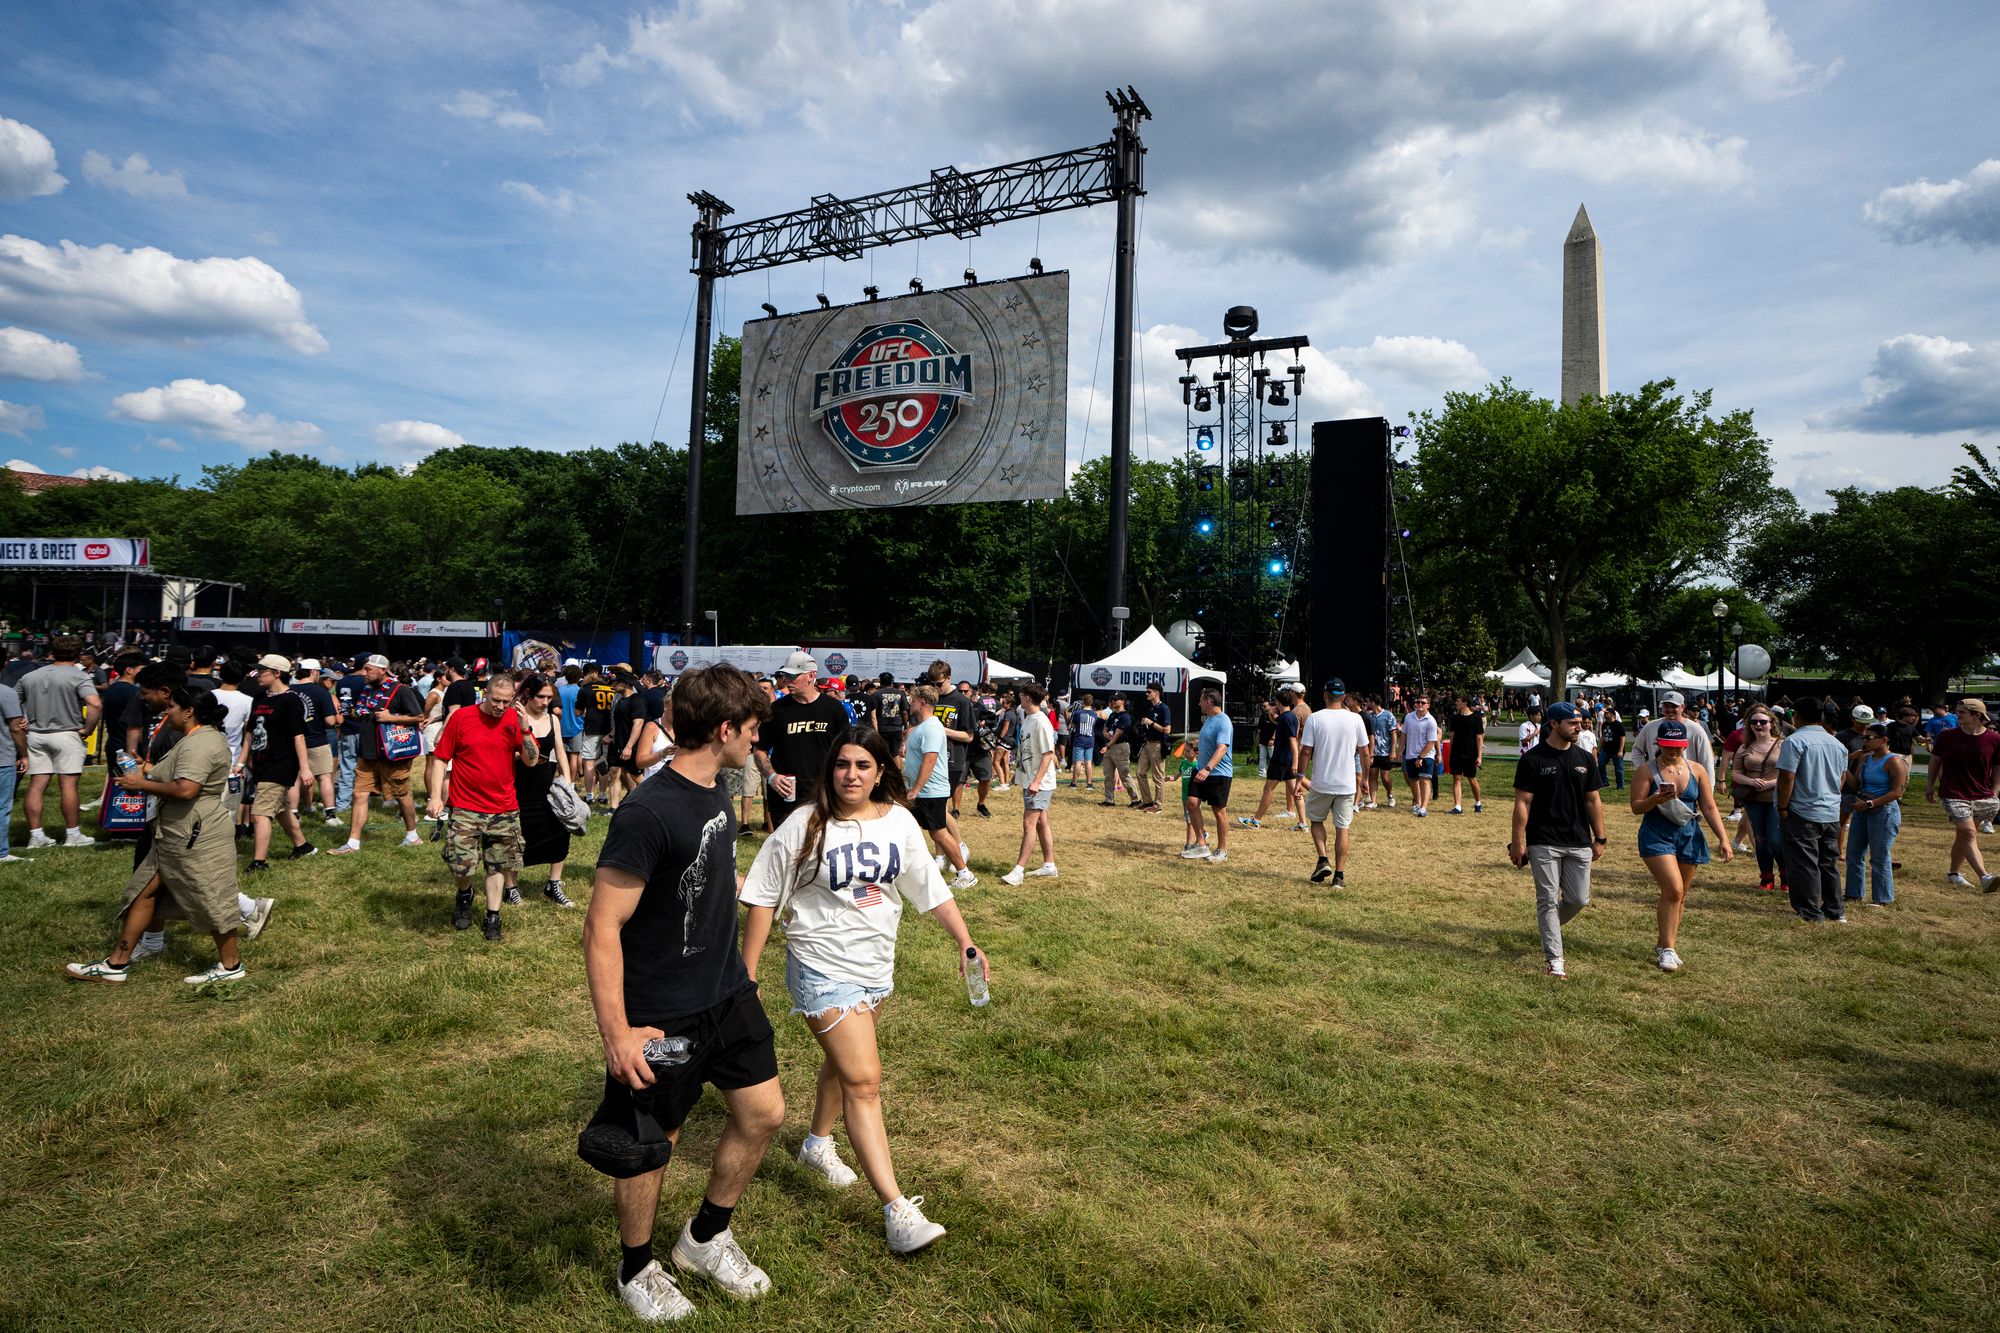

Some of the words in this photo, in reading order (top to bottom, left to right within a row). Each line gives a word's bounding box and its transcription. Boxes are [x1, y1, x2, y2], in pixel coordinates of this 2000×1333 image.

[869, 340, 913, 362] UFC
[812, 354, 973, 411] FREEDOM
[857, 399, 924, 441] 250
[839, 484, 881, 494] crypto.com
[911, 480, 948, 488] RAM
[29, 543, 38, 560] &
[41, 543, 77, 560] GREET
[87, 545, 108, 555] total
[1120, 671, 1131, 685] ID
[1133, 671, 1166, 686] CHECK
[787, 720, 815, 734] UFC
[814, 722, 828, 730] 317
[826, 841, 901, 892] USA
